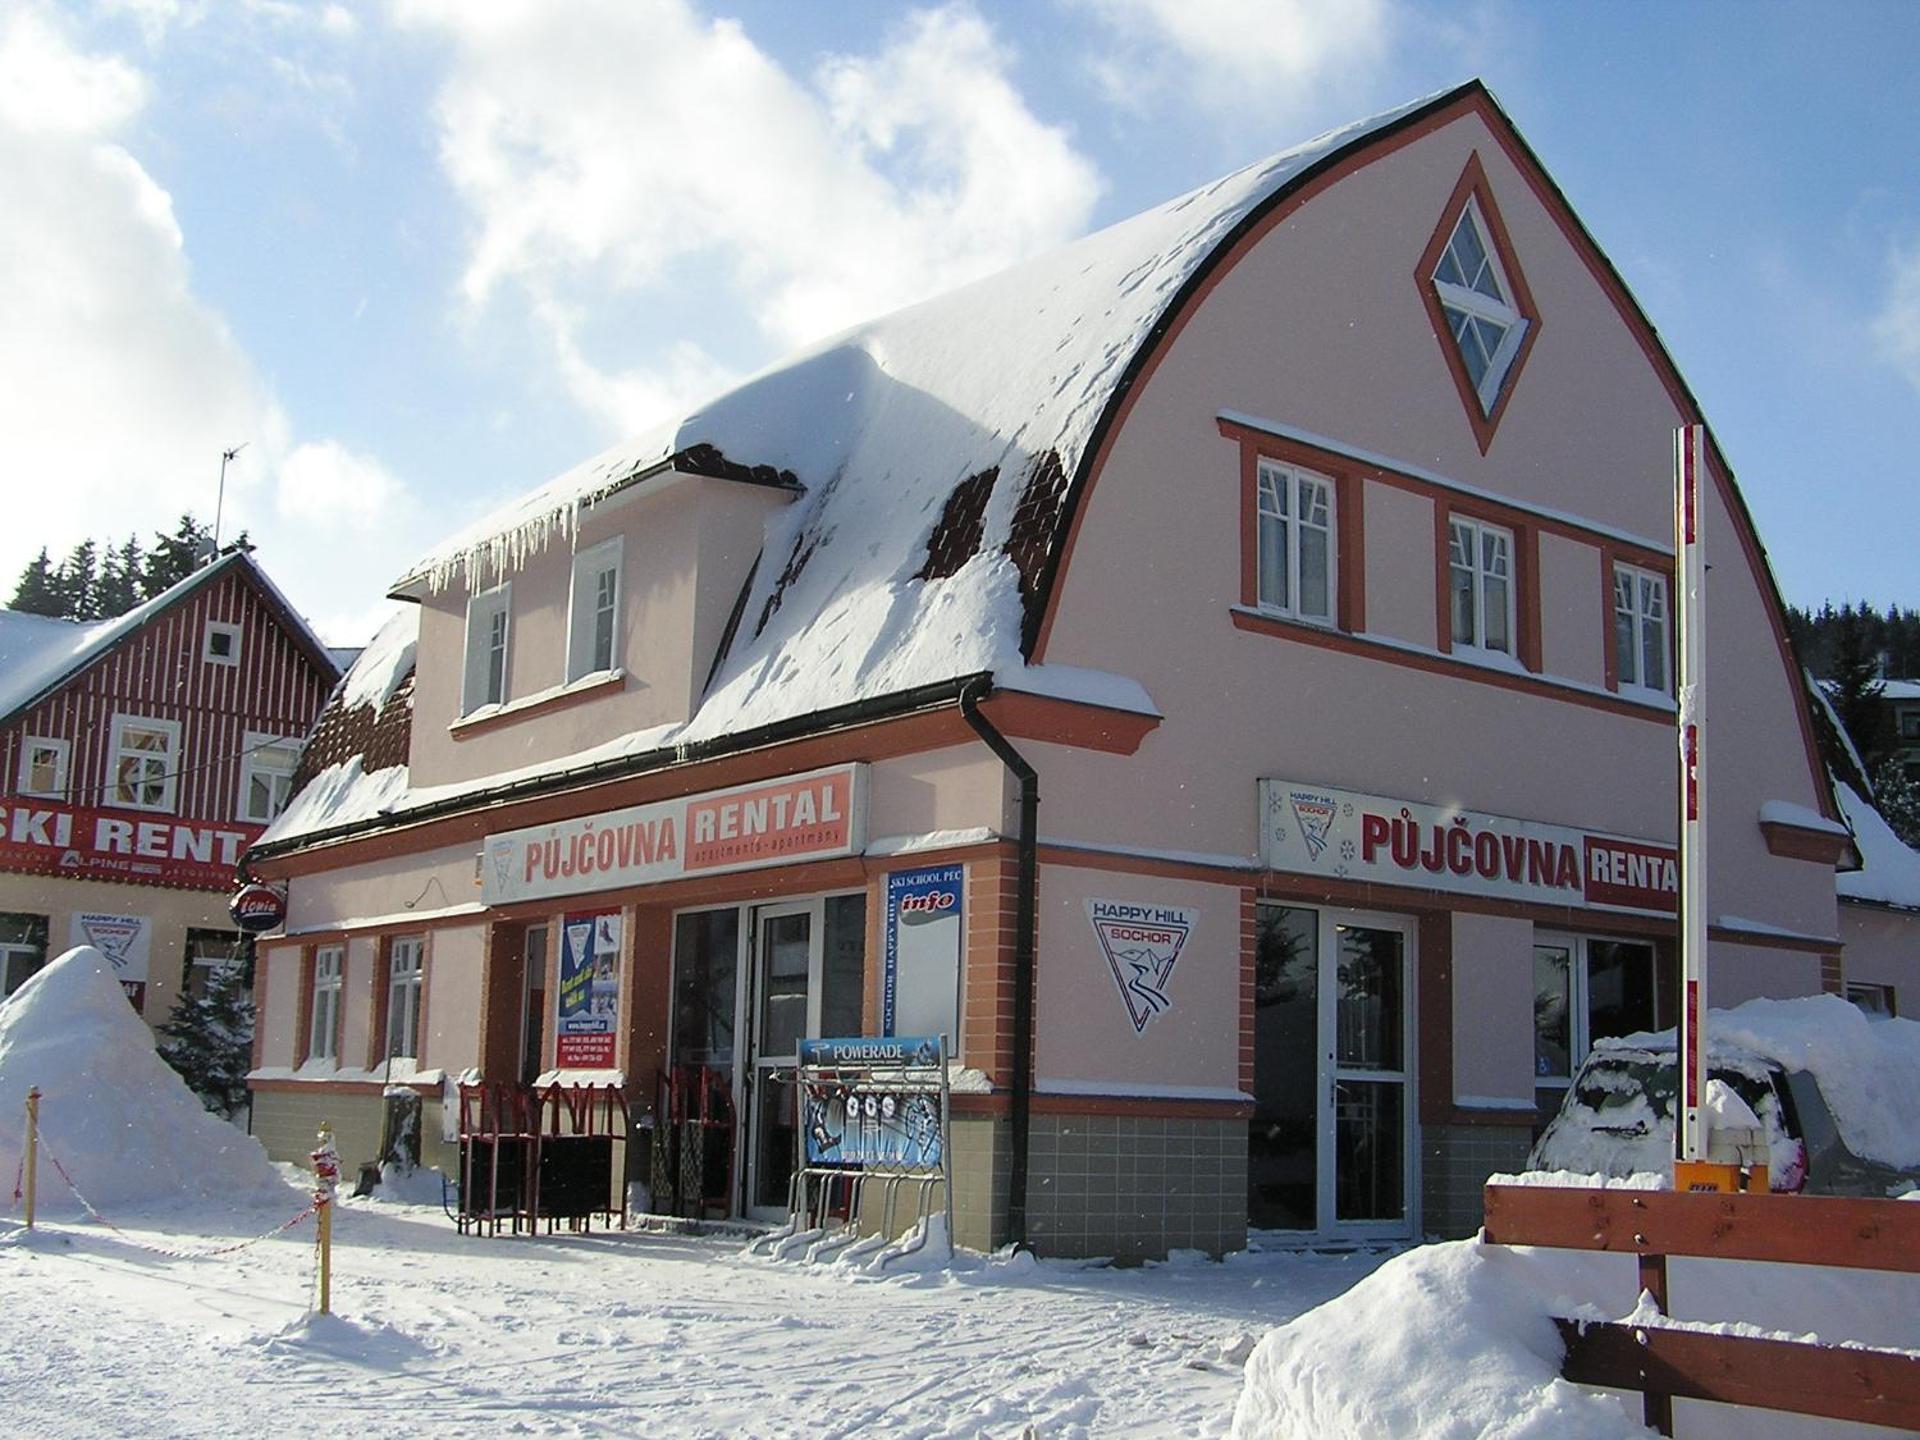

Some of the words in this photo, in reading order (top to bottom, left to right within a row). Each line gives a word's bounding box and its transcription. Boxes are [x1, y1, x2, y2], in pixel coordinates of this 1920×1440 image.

[0, 806, 73, 848] KI
[95, 817, 246, 866] RENT
[525, 817, 676, 882] PŮJČOVNA
[695, 785, 840, 844] RENTAL
[1362, 807, 1581, 890] PŮJČOVNA
[59, 849, 130, 871] ALPINE
[891, 875, 905, 887] SKI
[906, 872, 942, 886] SCHOOL
[902, 891, 955, 913] info
[1093, 903, 1152, 921] HAPPY
[1155, 910, 1189, 925] HILL
[1111, 928, 1171, 944] SOCHOR
[887, 926, 895, 969] HAPPY
[885, 974, 894, 1030] SOCHOR
[833, 1044, 905, 1060] POWERADE
